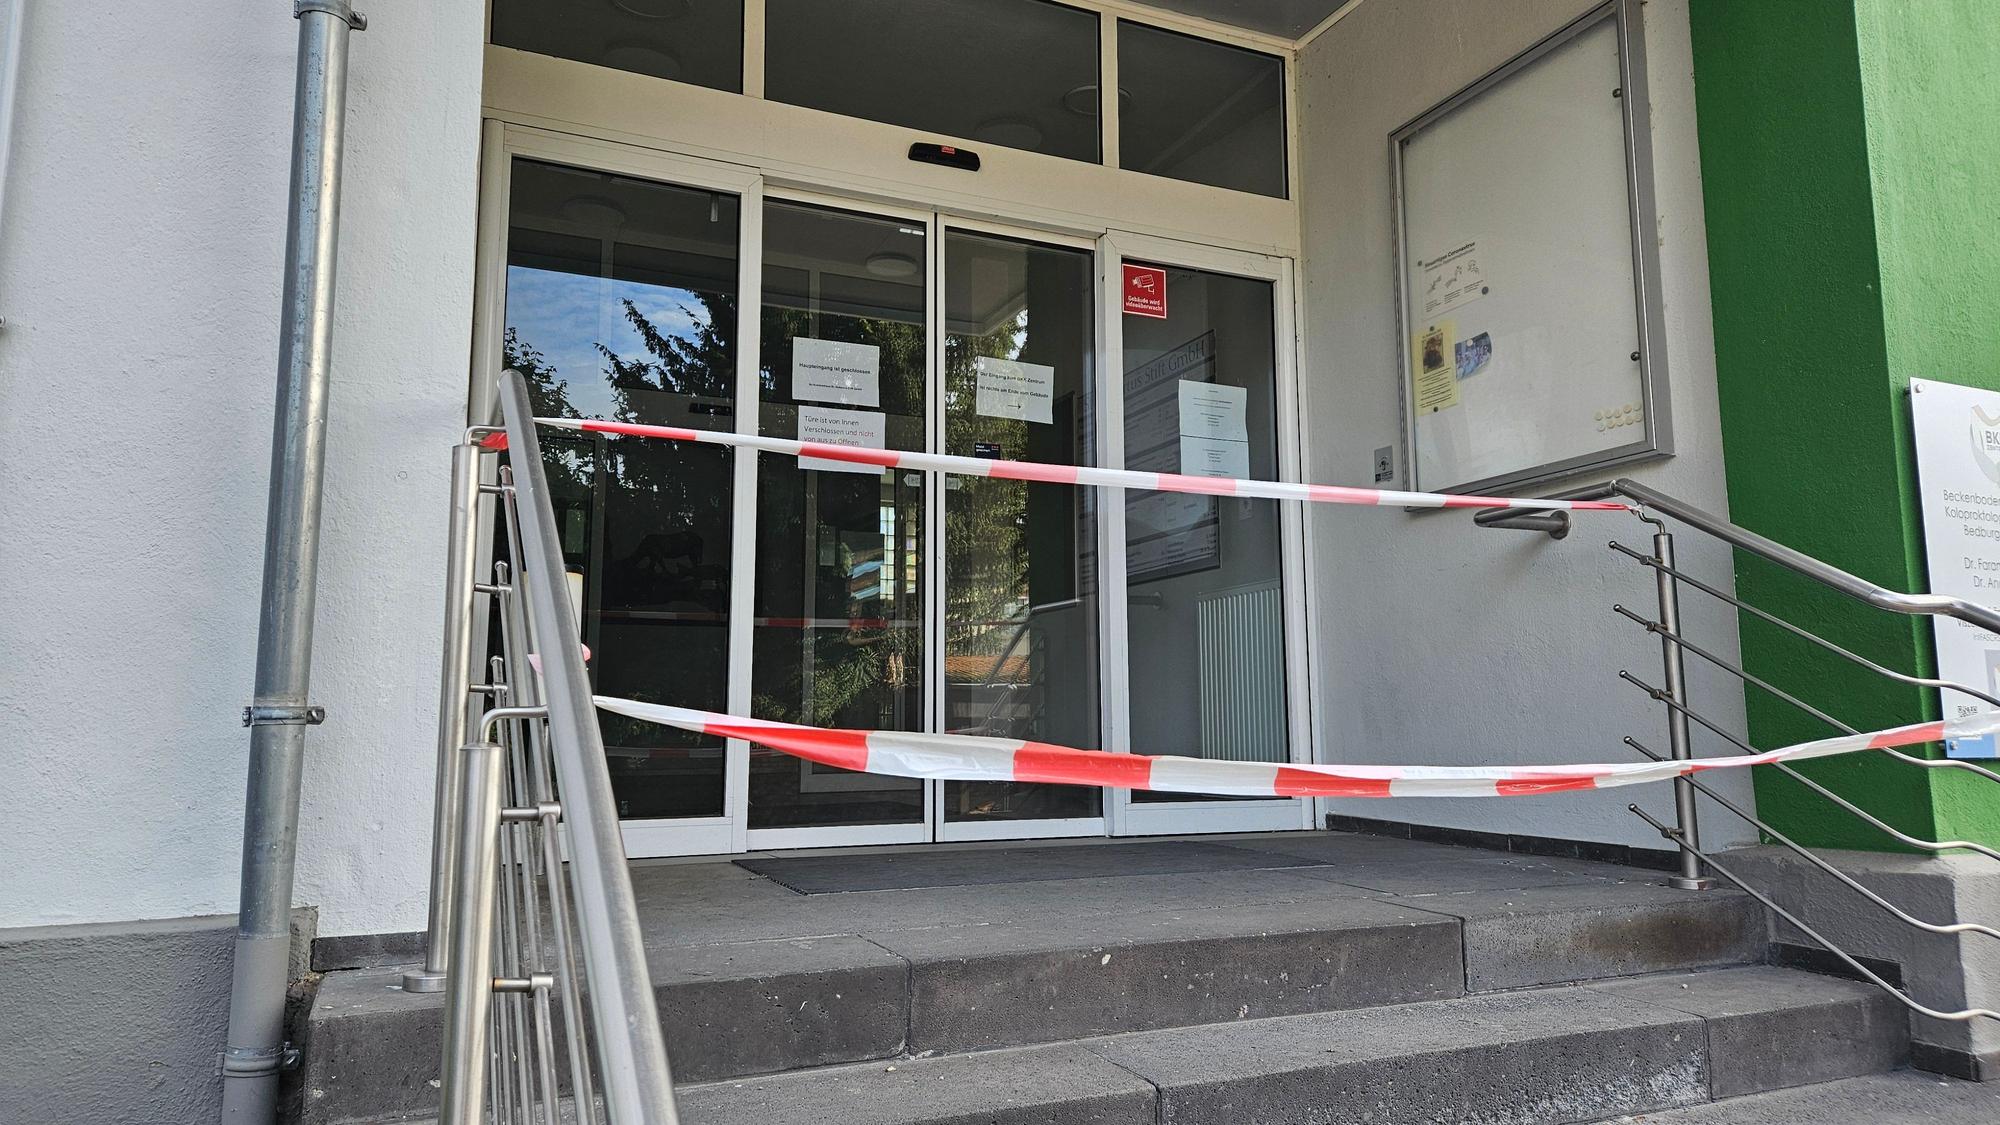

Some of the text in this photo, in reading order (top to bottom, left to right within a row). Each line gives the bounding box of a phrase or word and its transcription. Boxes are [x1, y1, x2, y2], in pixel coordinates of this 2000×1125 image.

[1144, 361, 1167, 383] Stift
[1168, 340, 1205, 371] GmbH
[805, 415, 819, 423] Türe
[804, 426, 844, 435] Verschlossen
[1943, 489, 2000, 506] Beckenbode
[1944, 506, 2000, 524] Koloproktolo
[1964, 557, 1977, 569] Dr.
[1973, 575, 2000, 589] Dr. An
